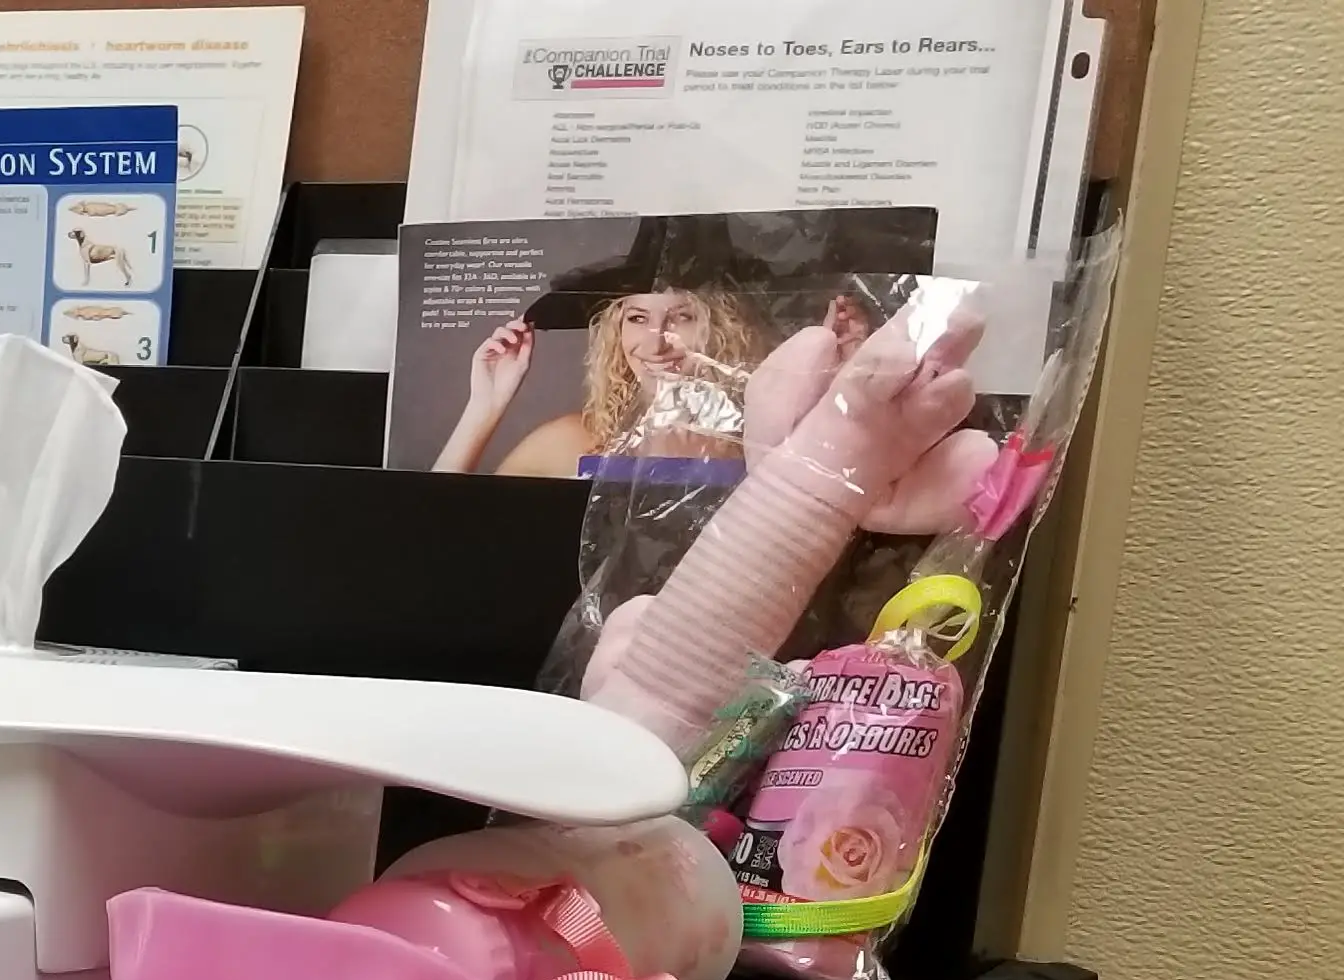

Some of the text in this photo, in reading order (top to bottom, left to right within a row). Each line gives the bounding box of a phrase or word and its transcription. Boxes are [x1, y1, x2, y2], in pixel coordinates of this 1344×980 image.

[106, 39, 250, 52] heartworm disease
[532, 47, 631, 64] Companion
[637, 44, 671, 62] Trial
[689, 37, 996, 58] Noses to Toes, Ears to Rears...
[574, 63, 666, 78] CHALLENGE
[48, 148, 157, 176] SYSTEM
[146, 230, 158, 254] 1
[136, 336, 153, 361] 3
[803, 668, 877, 704] ARBAGE
[784, 722, 810, 751] CS
[777, 769, 822, 787] SCENTED
